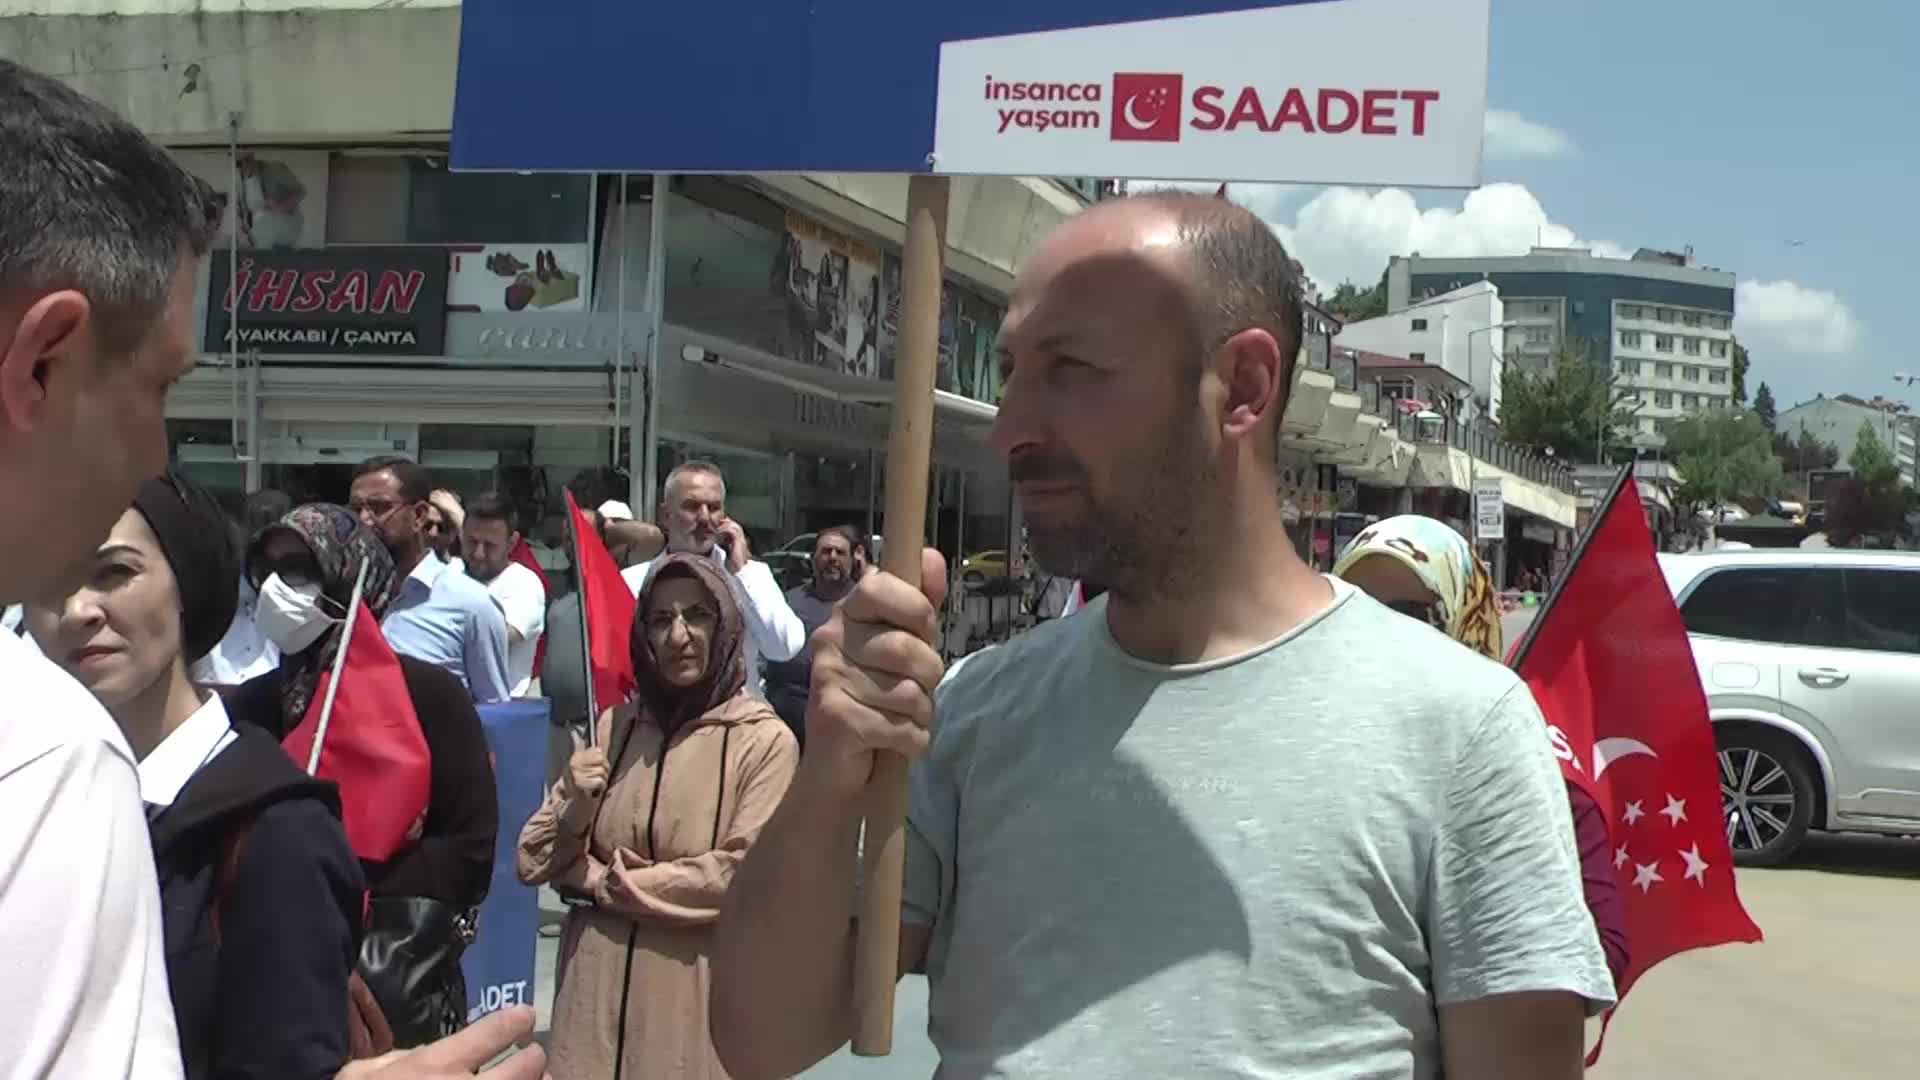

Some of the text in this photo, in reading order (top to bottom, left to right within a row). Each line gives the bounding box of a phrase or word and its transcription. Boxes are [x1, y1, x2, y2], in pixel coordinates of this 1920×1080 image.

[984, 75, 1101, 102] insanca
[997, 105, 1100, 134] yaşam
[1190, 87, 1440, 136] SAADET
[223, 256, 425, 315] İHSAN
[223, 328, 326, 345] AYAKKABI
[343, 329, 417, 347] ÇANTA
